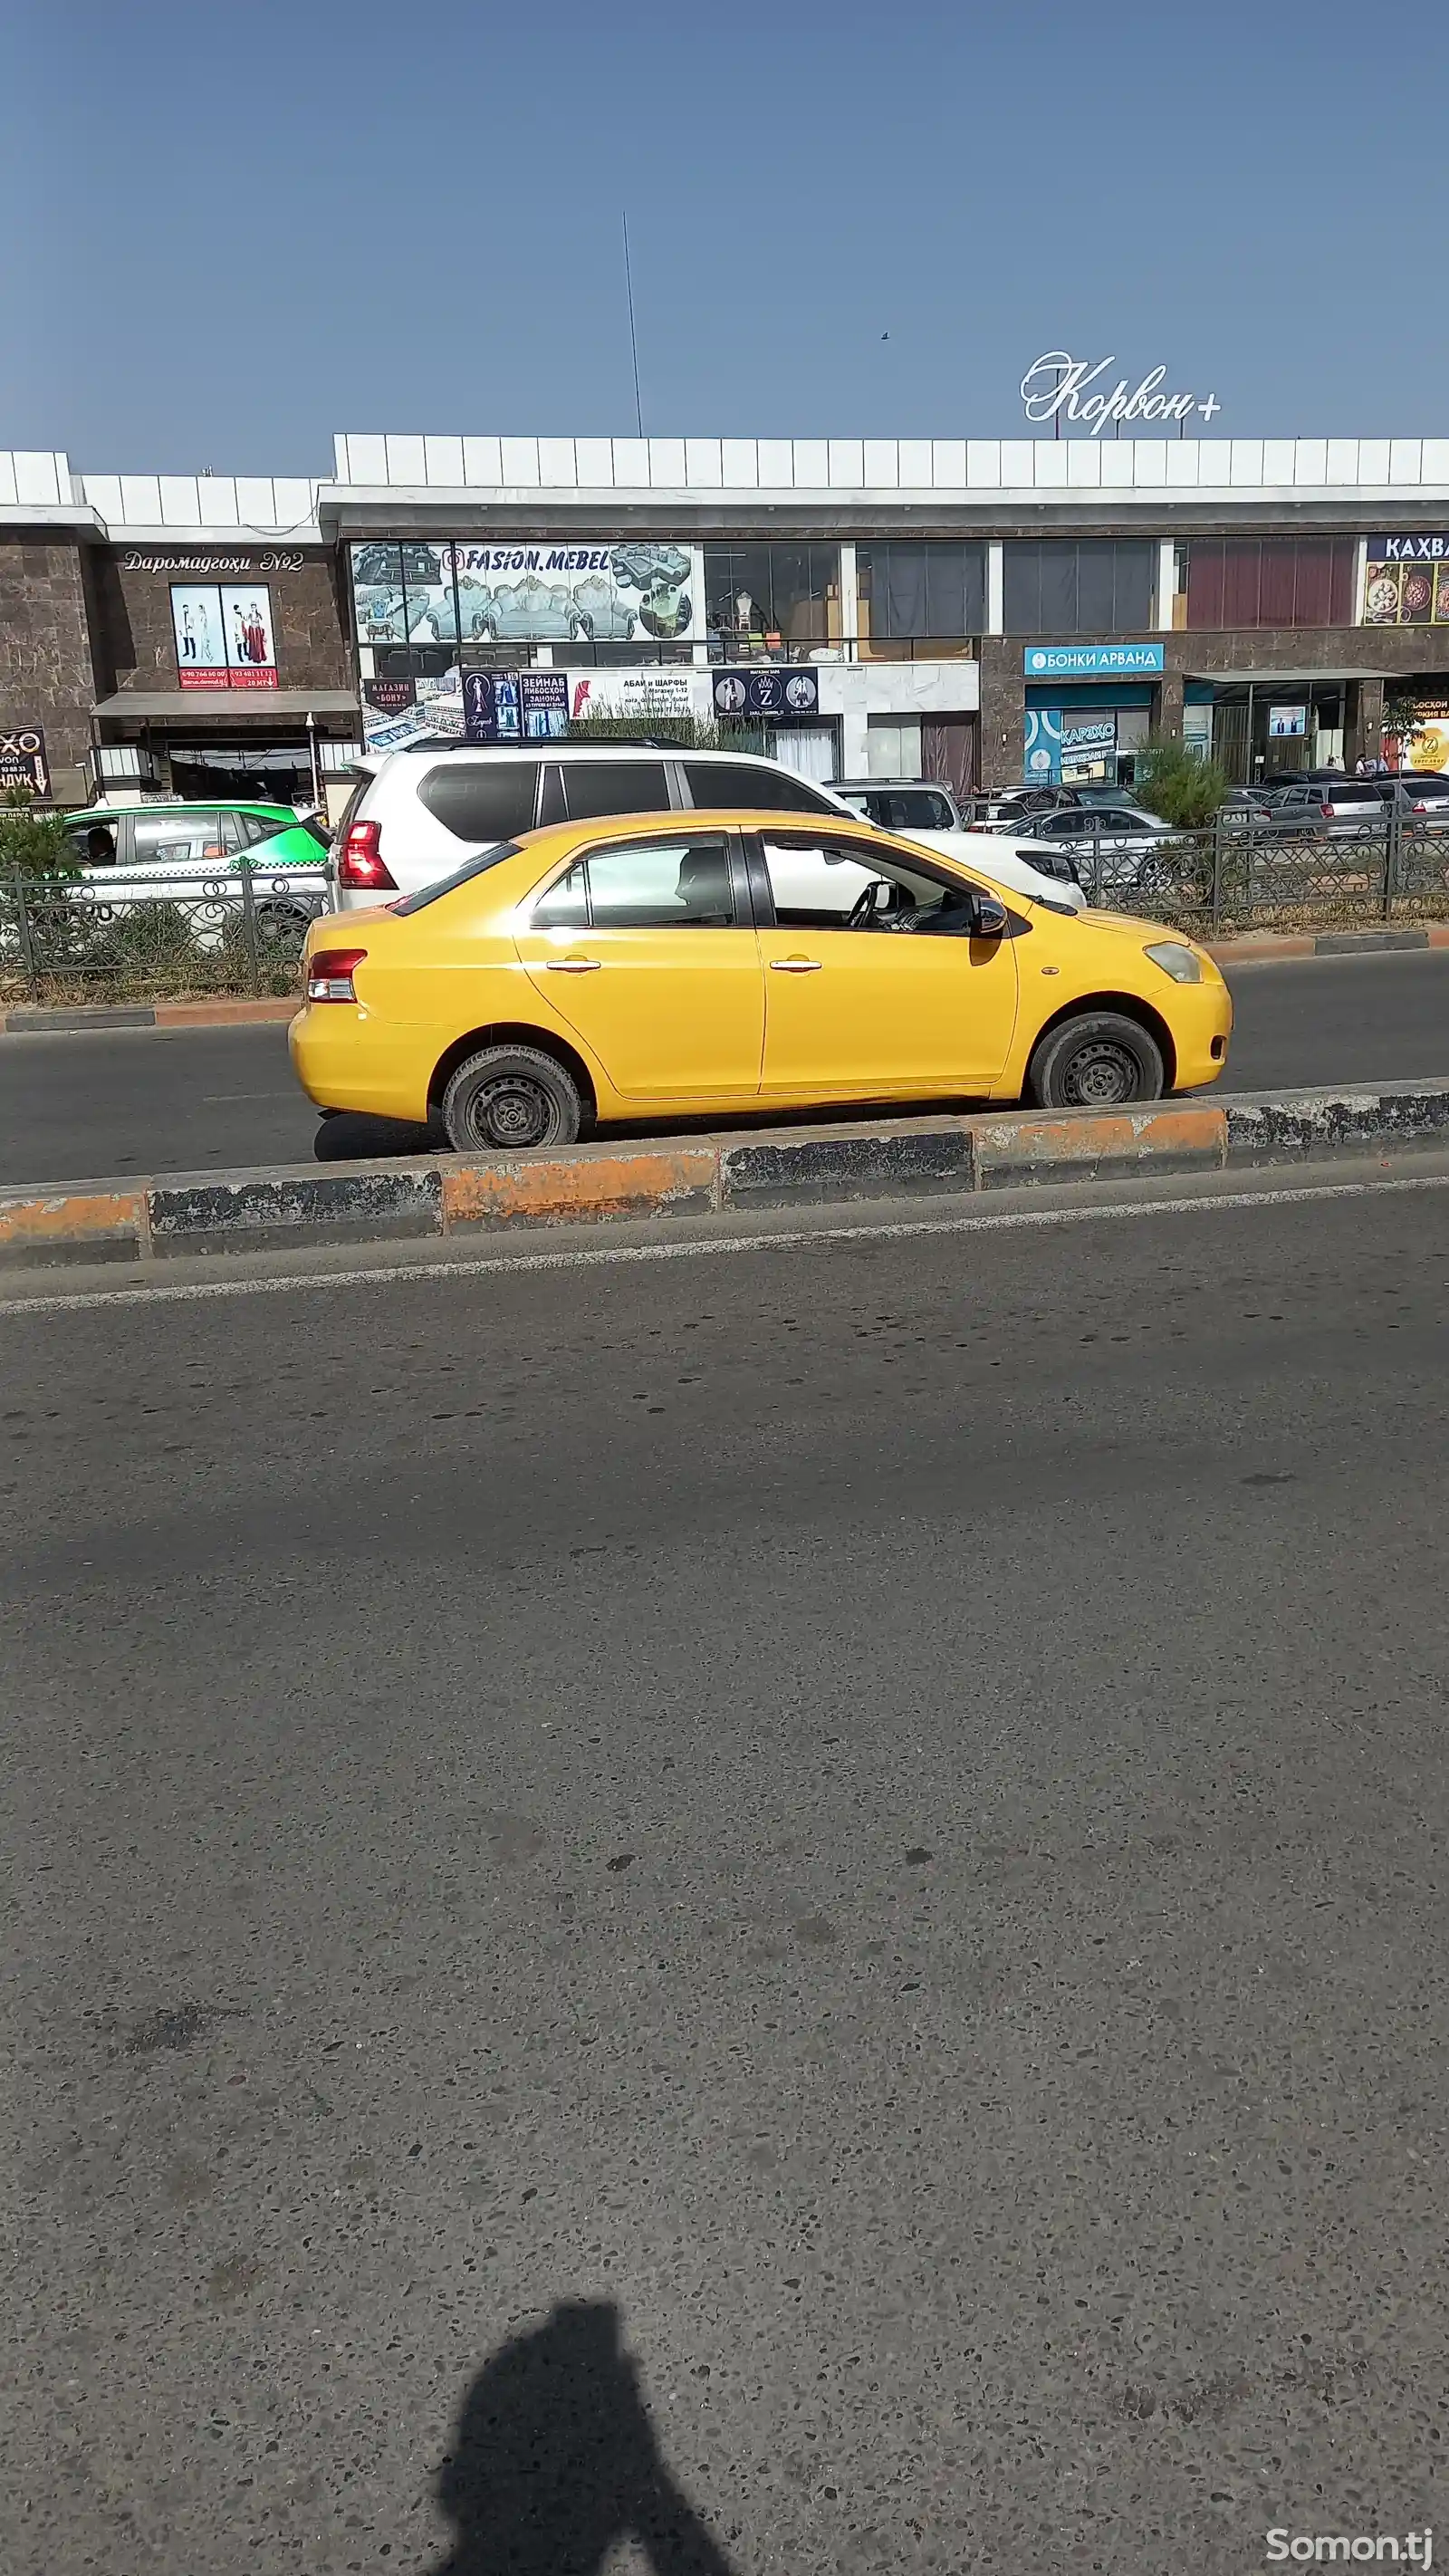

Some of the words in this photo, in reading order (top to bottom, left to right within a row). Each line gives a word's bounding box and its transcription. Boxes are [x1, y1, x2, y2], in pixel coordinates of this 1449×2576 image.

[1048, 654, 1096, 668] БОНКИ
[1099, 651, 1156, 666] АРВАНД
[523, 675, 565, 687] ЗЕЙНАБ
[655, 678, 687, 687] ШАРФЫ
[371, 684, 410, 692] МАГАЗИН
[530, 695, 561, 703] ЗАНОНА
[760, 689, 772, 706] Z
